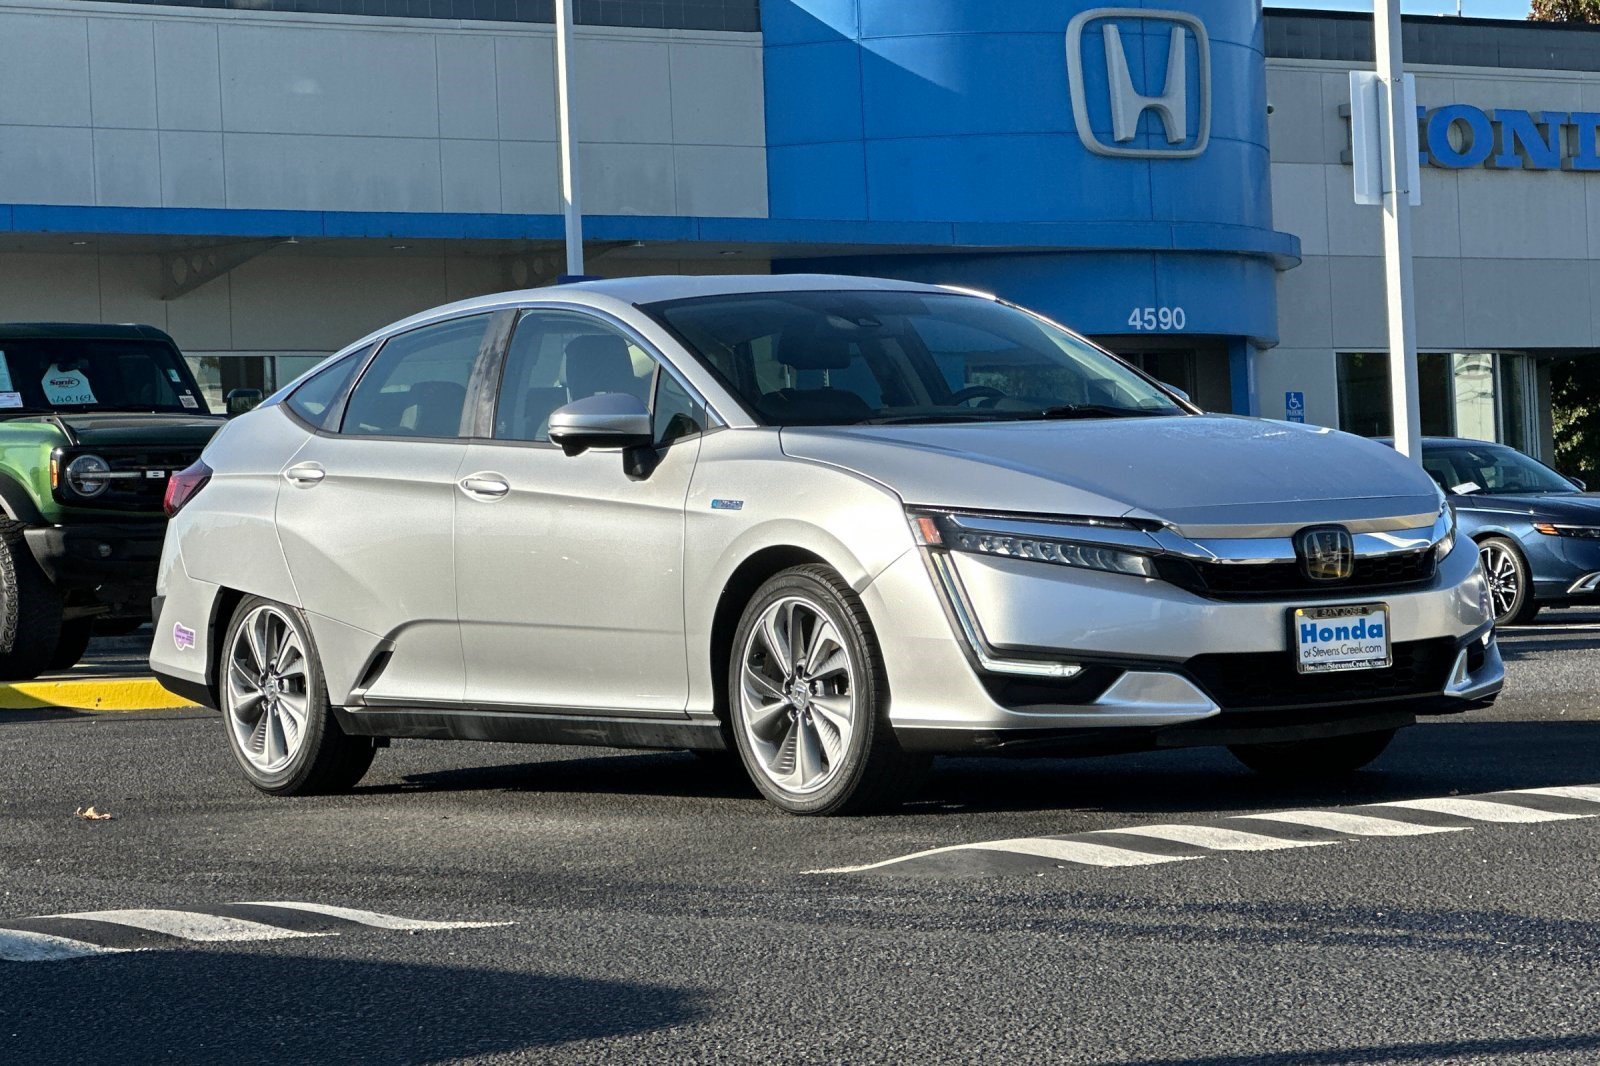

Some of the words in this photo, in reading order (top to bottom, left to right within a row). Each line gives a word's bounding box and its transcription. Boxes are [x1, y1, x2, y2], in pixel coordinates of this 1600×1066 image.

[1339, 104, 1600, 171] ON
[1128, 307, 1185, 330] 4590
[50, 378, 75, 386] Sonic
[1301, 618, 1384, 643] Honda
[1304, 648, 1311, 658] of
[1312, 646, 1340, 657] Stevens
[1341, 641, 1382, 655] Creek.com
